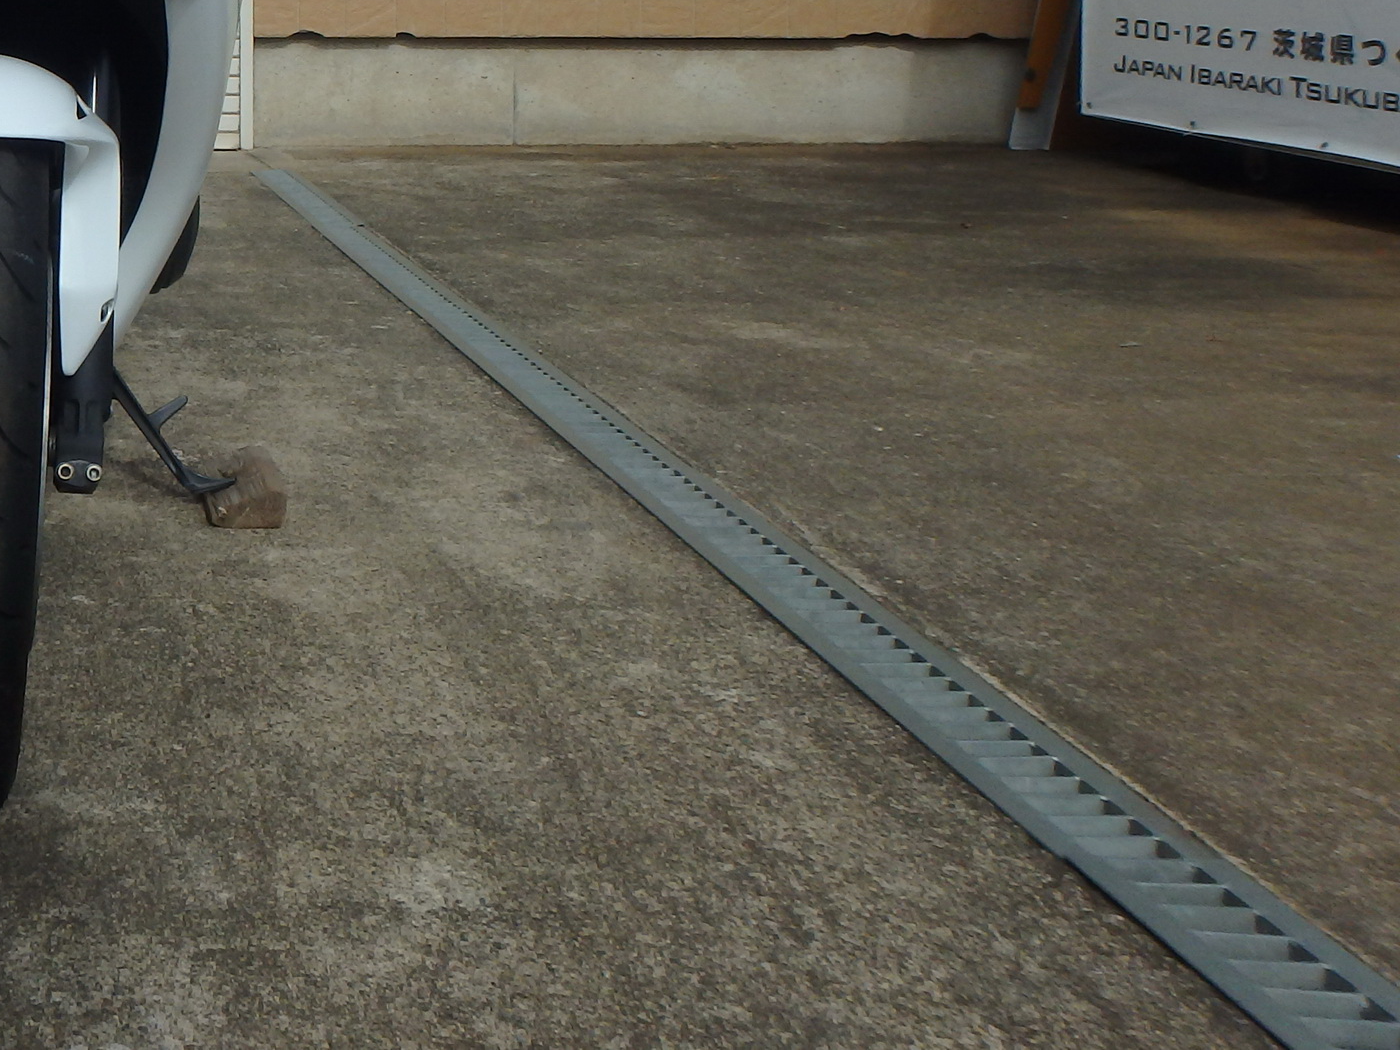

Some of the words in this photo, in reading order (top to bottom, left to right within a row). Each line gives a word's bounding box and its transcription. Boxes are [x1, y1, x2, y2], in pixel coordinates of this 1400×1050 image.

[1114, 17, 1258, 51] 300-1267
[1272, 28, 1400, 66] 茨城県つ
[1113, 55, 1183, 81] JAPAN
[1190, 64, 1282, 96] IBARAKI
